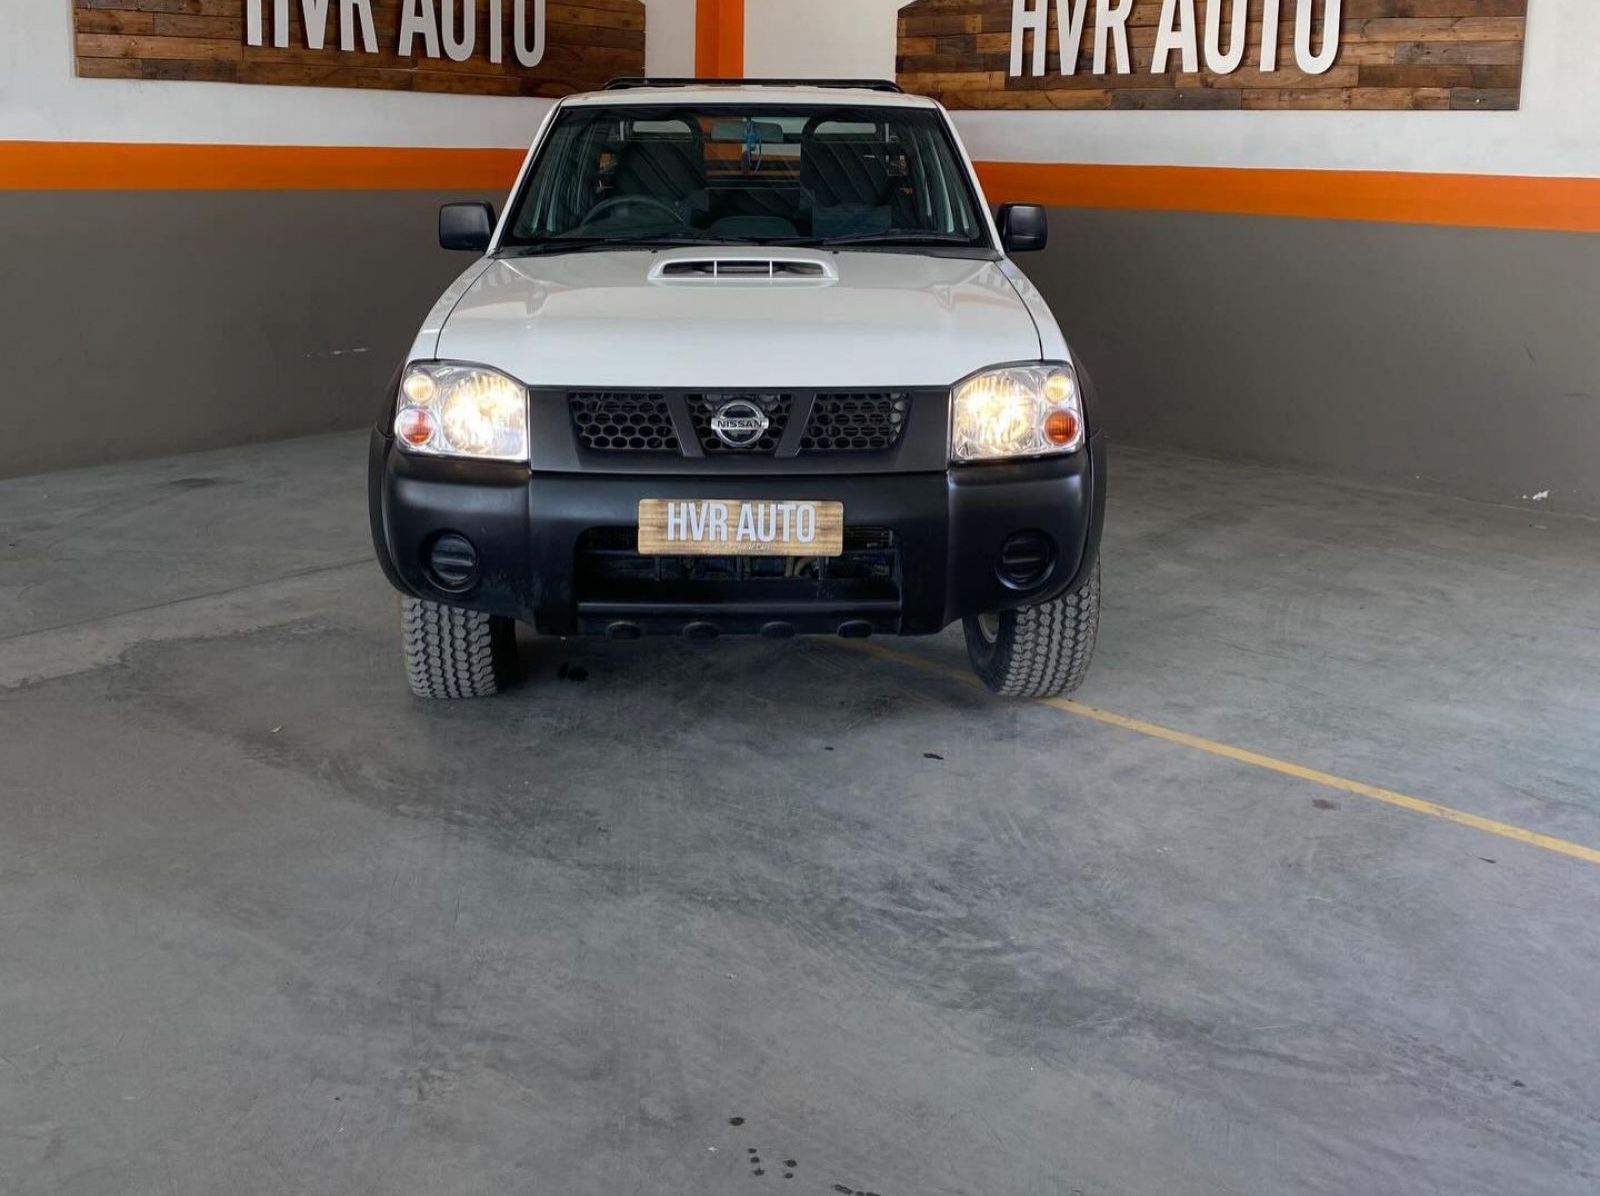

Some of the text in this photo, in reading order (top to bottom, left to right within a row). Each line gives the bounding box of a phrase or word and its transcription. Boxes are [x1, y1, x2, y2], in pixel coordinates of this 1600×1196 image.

[1009, 0, 1340, 76] HVR AUTO
[717, 419, 762, 428] NISSAN
[667, 502, 816, 542] HVR AUTO
